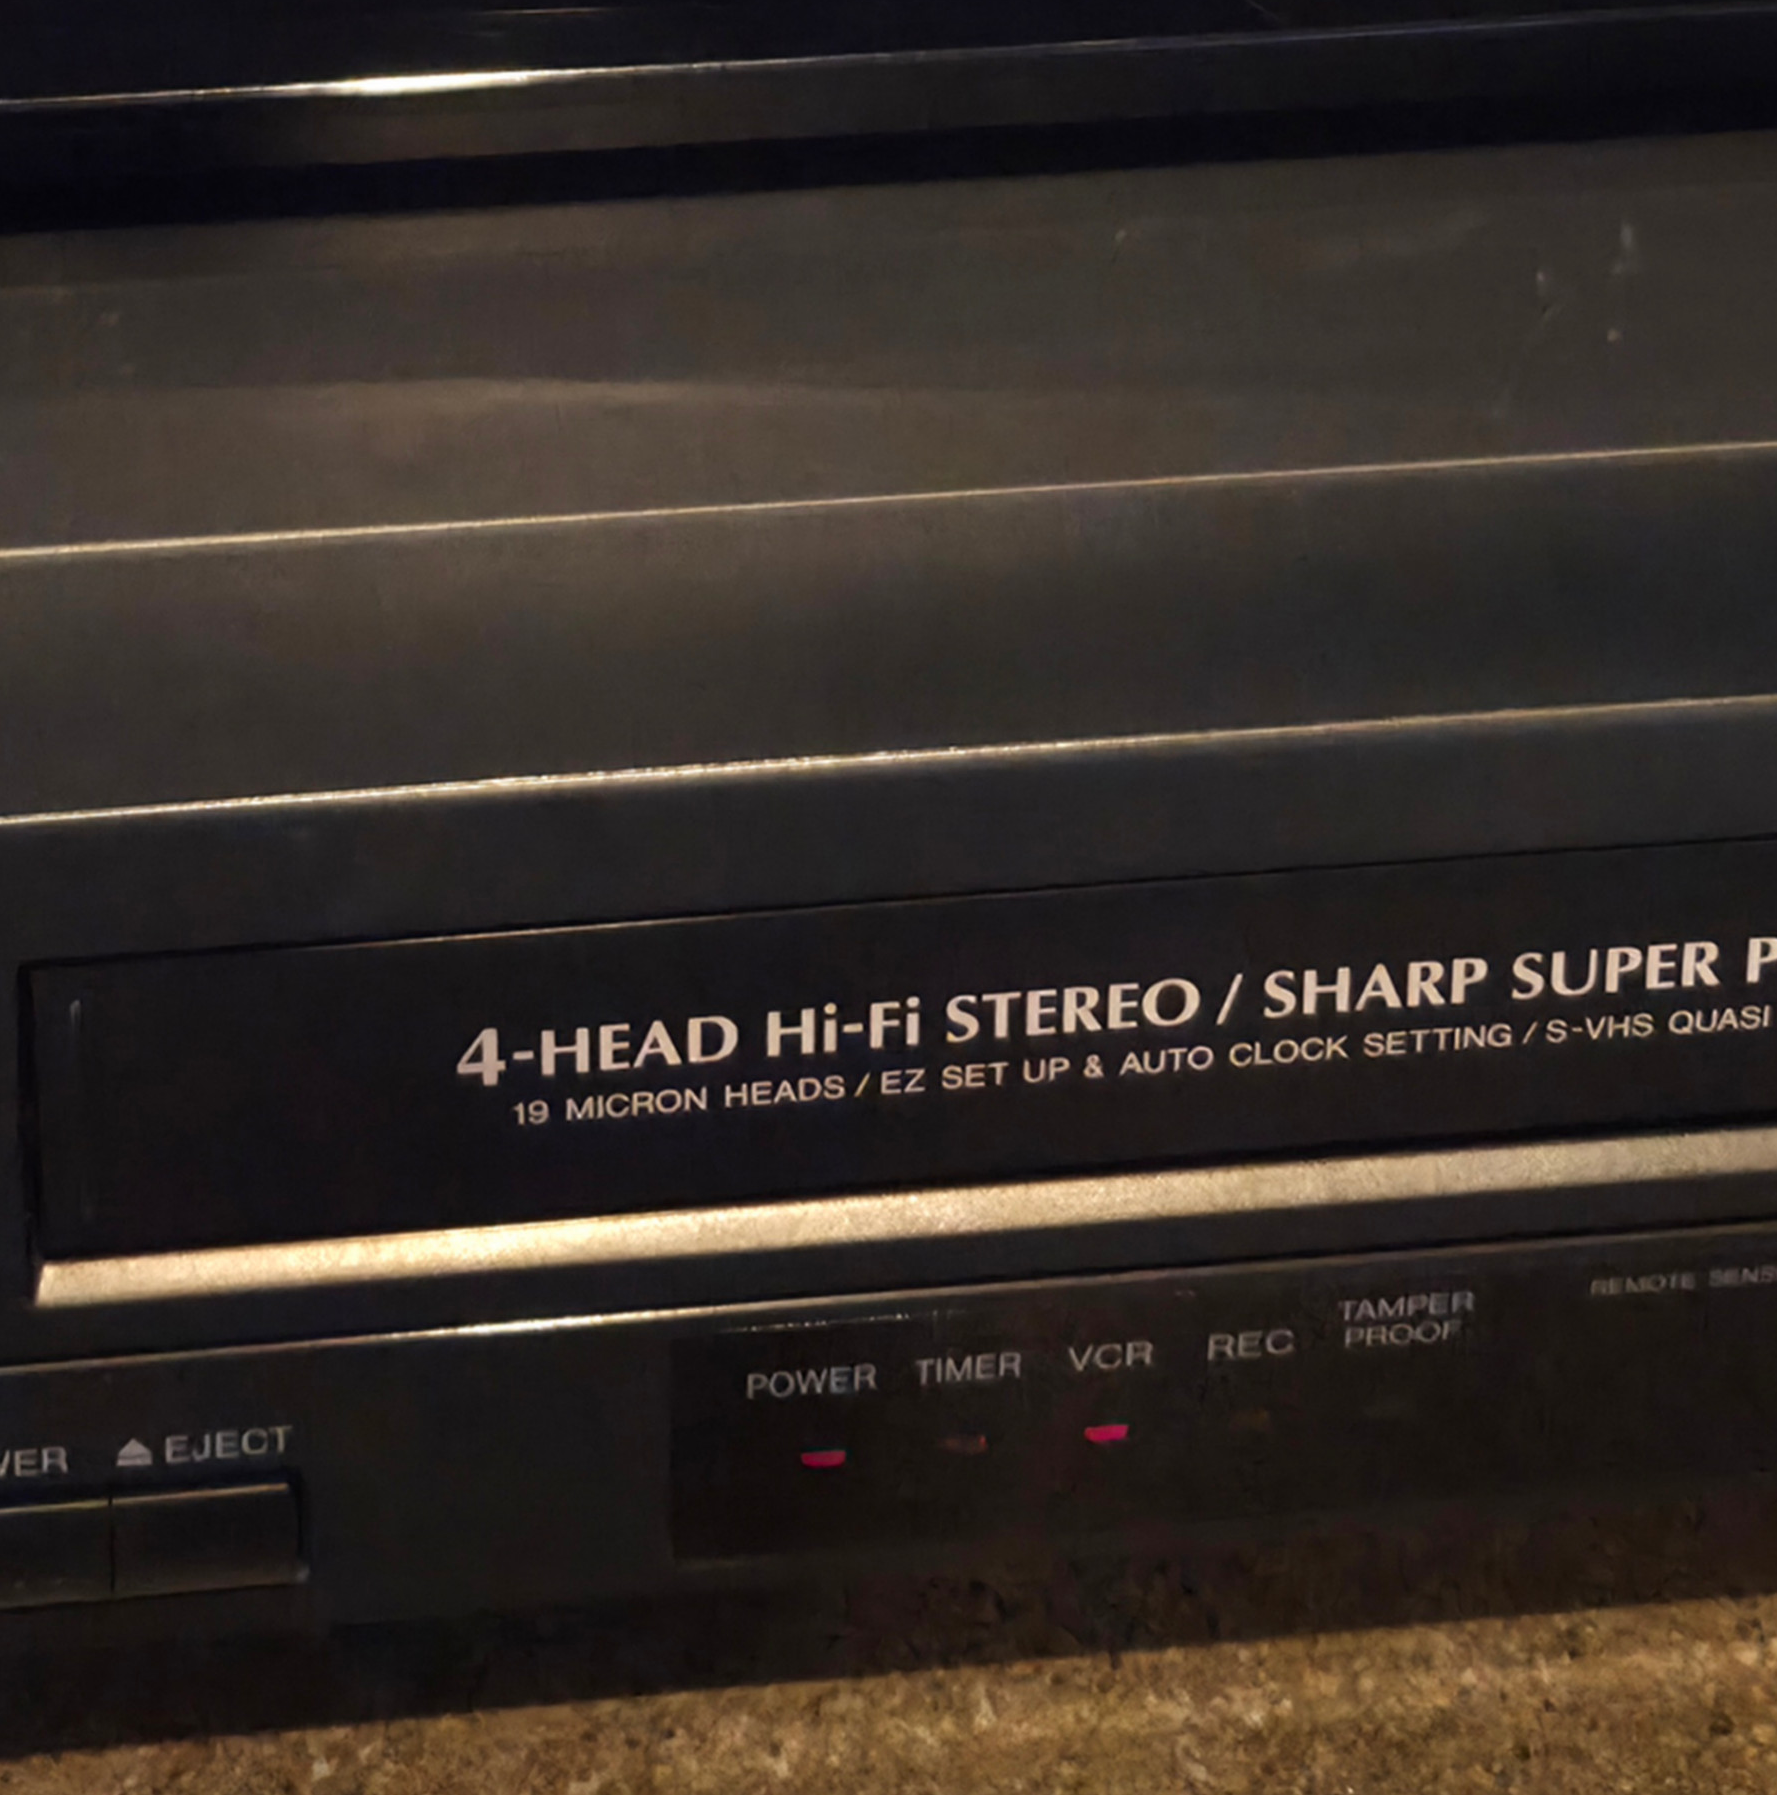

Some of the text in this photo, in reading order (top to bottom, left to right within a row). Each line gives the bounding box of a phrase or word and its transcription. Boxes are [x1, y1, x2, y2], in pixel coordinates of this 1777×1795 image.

[456, 1015, 739, 1088] 4-HEAD
[766, 997, 920, 1057] Hi-Fi
[946, 978, 1201, 1043] STEREO
[1263, 957, 1488, 1019] SHARP
[1511, 941, 1720, 1000] SUPER
[513, 1099, 549, 1125] 19
[566, 1086, 708, 1121] MICRON
[724, 1075, 846, 1108] HEADS
[880, 1068, 926, 1095] EZ
[941, 1061, 1009, 1090] SET
[1023, 1057, 1071, 1084] UP
[1083, 1054, 1104, 1079] &
[1119, 1045, 1214, 1076] AUTO
[1228, 1035, 1349, 1068] CLOCK
[1363, 1023, 1512, 1058] SETTING
[1545, 1012, 1654, 1044] S-VHS
[1668, 1005, 1771, 1035] QUASI
[1590, 1271, 1696, 1296] REMOTE
[1338, 1290, 1477, 1322] TAMPER
[1207, 1329, 1294, 1361] REC
[1344, 1318, 1463, 1348] PROOF
[916, 1351, 1022, 1385] TIMER
[1068, 1341, 1154, 1372] VCR
[747, 1363, 877, 1399] POWER
[164, 1425, 291, 1464] EJECT
